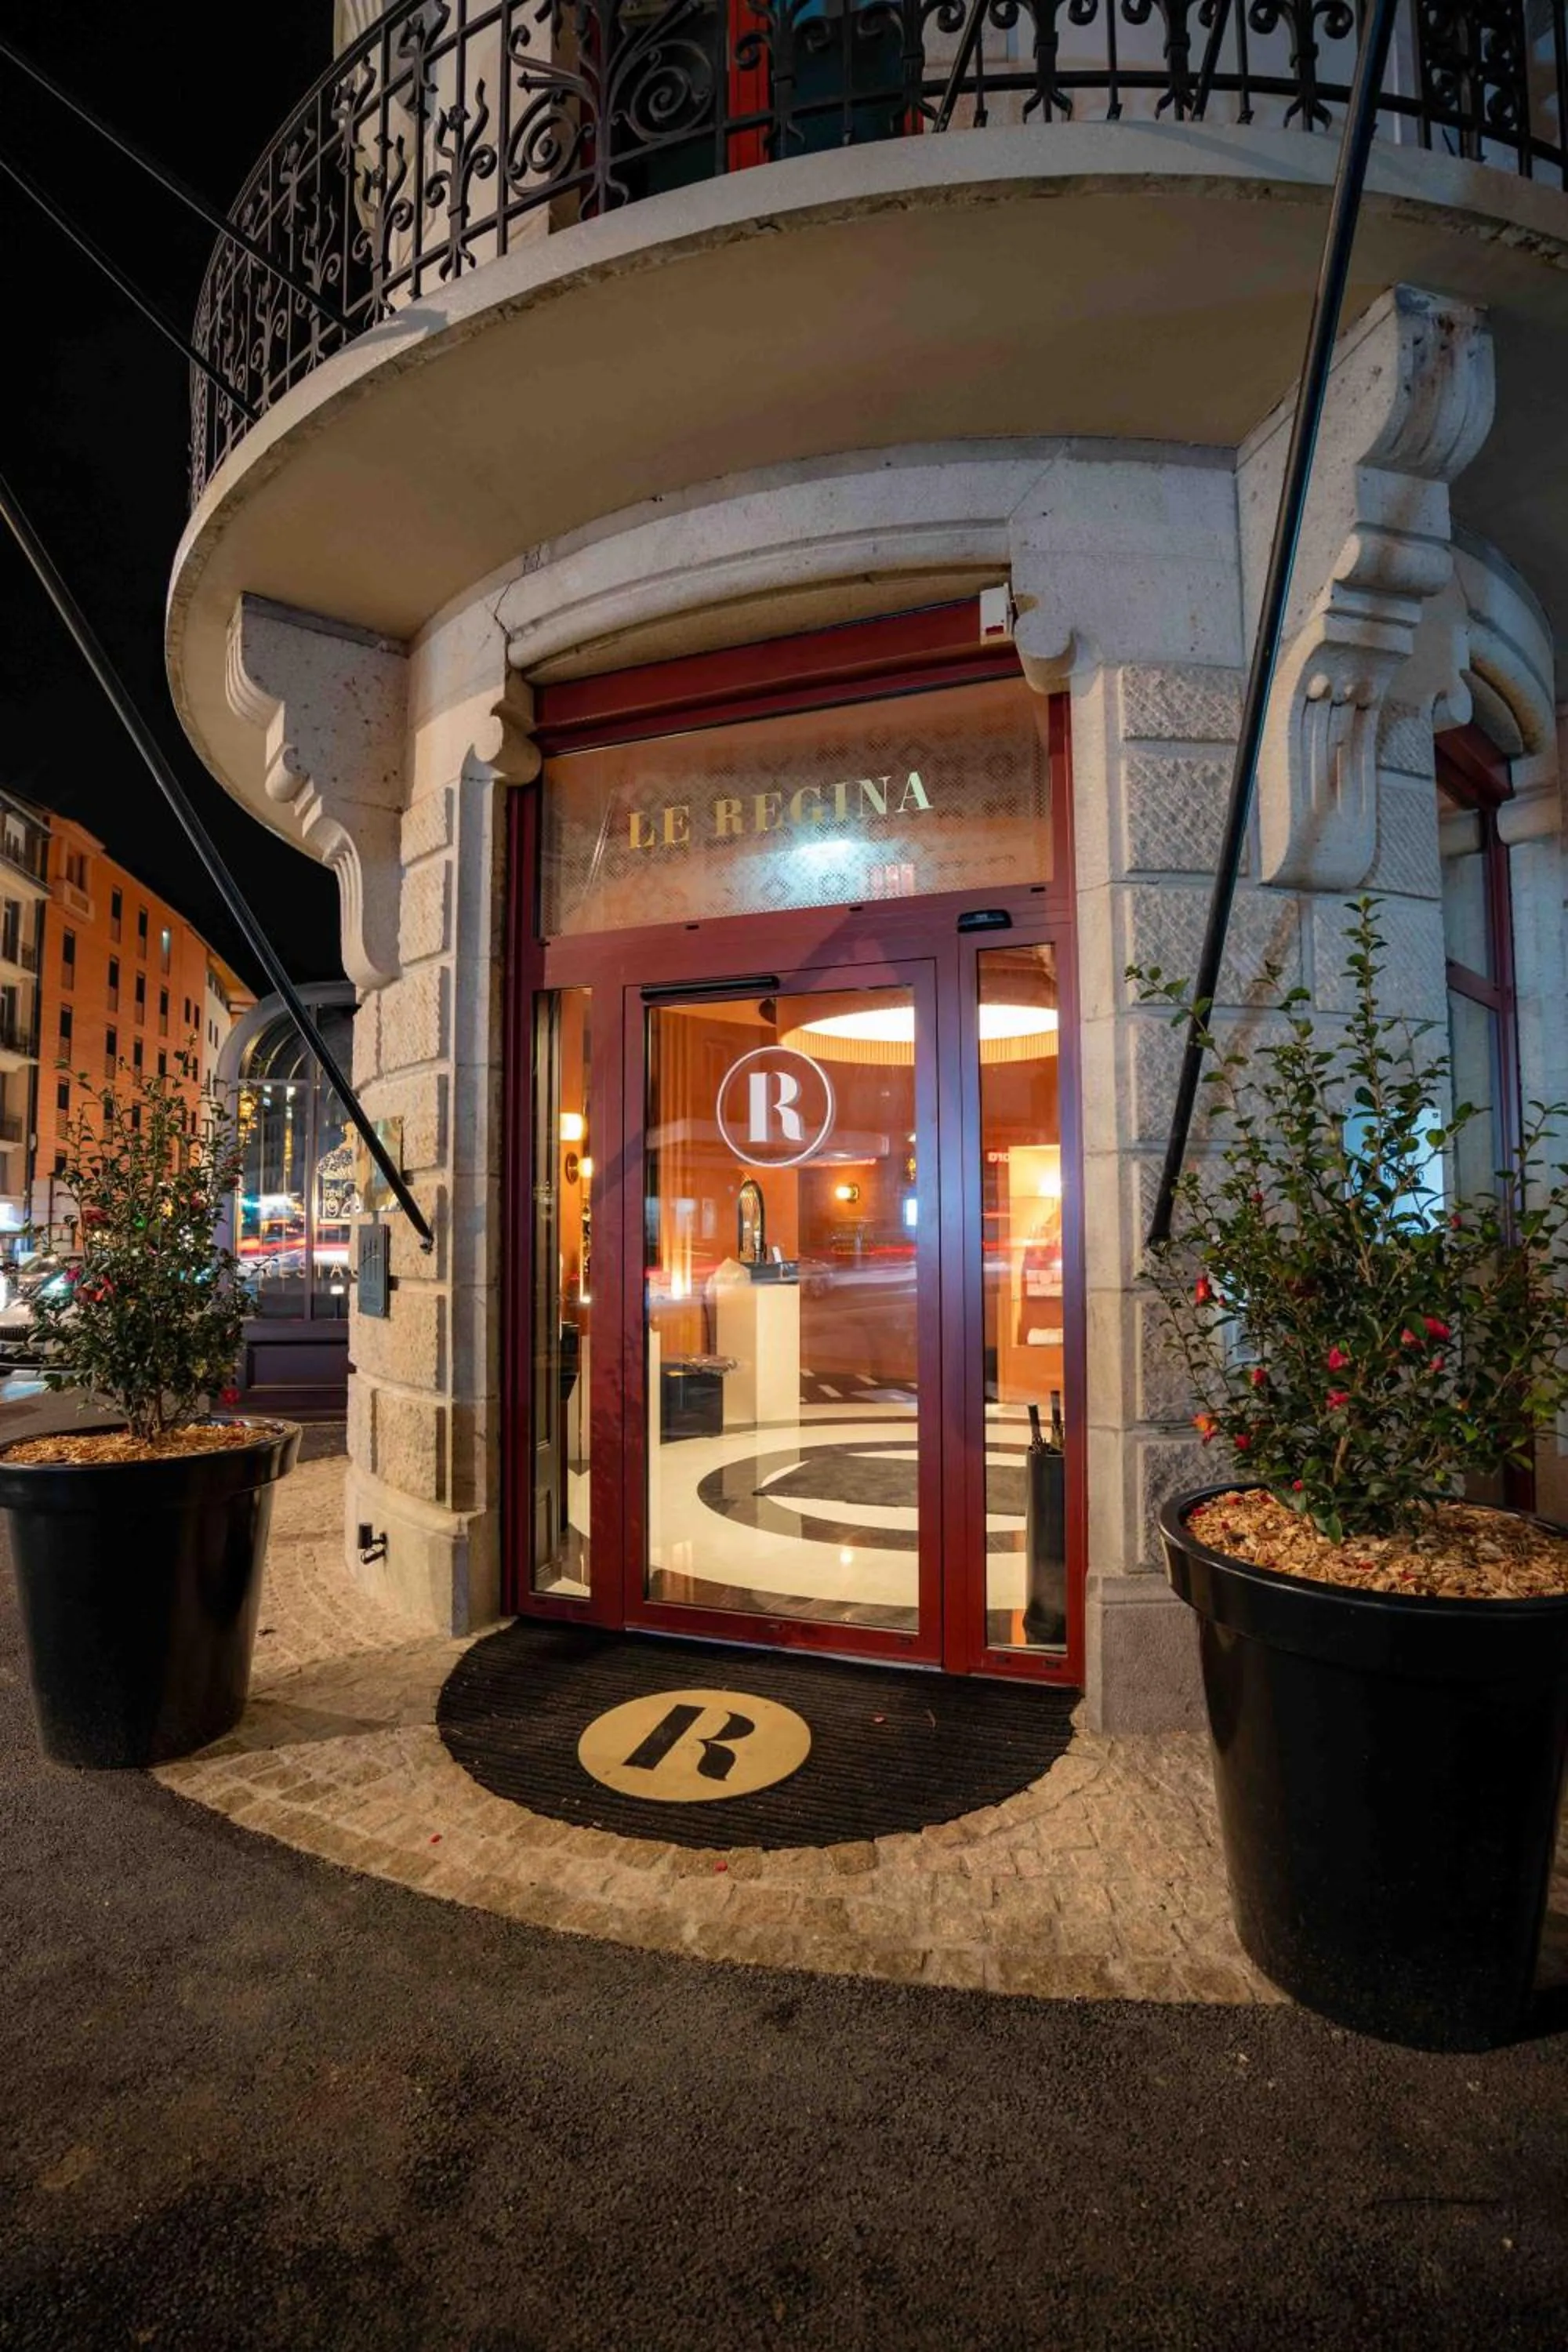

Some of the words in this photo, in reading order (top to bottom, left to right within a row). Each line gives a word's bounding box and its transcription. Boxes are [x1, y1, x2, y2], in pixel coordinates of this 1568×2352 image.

[627, 805, 691, 849] LE
[713, 771, 935, 837] REGINA
[750, 1072, 803, 1142] R
[622, 1704, 755, 1781] R
